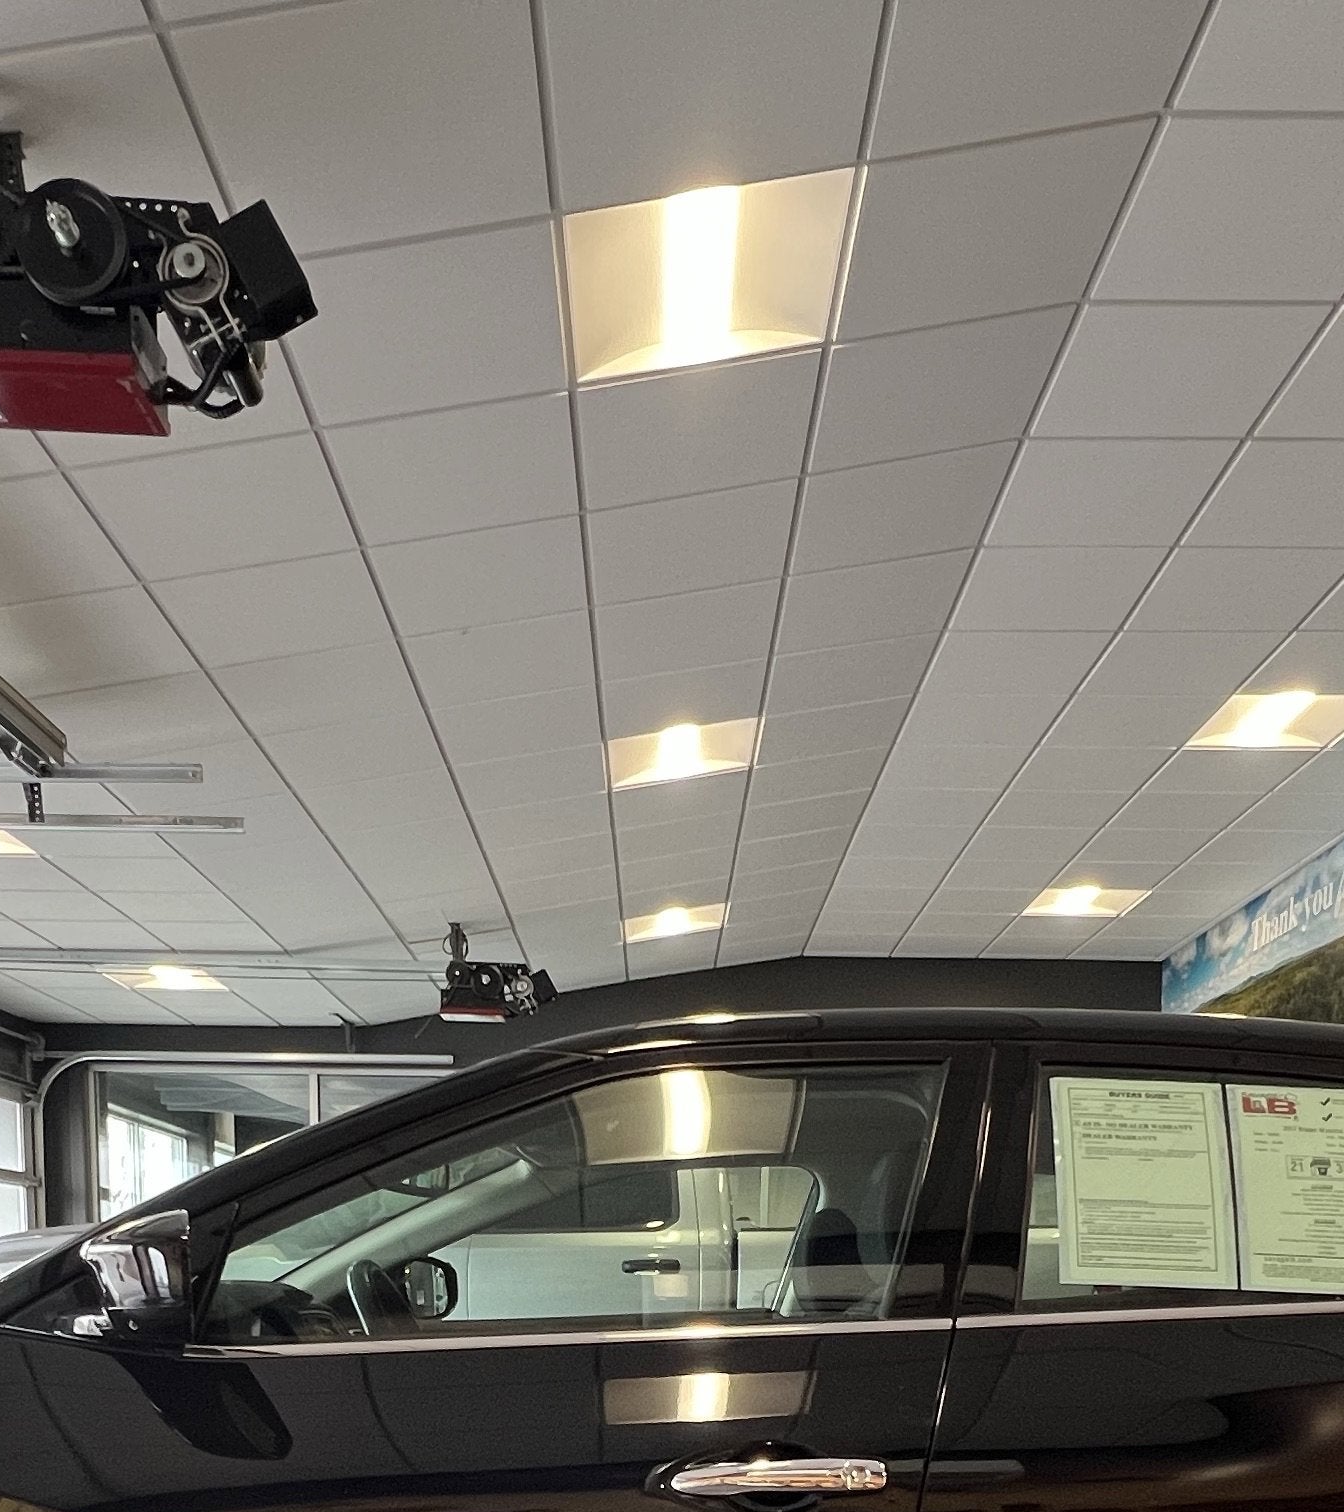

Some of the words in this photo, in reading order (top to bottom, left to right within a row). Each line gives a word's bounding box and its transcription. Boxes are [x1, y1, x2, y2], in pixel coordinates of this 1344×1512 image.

[1251, 896, 1298, 952] Thank
[1301, 881, 1334, 932] you
[1145, 1092, 1171, 1100] GUIDE
[1149, 1123, 1193, 1131] WARRANTY
[1082, 1132, 1113, 1140] DEALER
[1114, 1133, 1158, 1141] WARRANTY
[1290, 1160, 1304, 1172] 21
